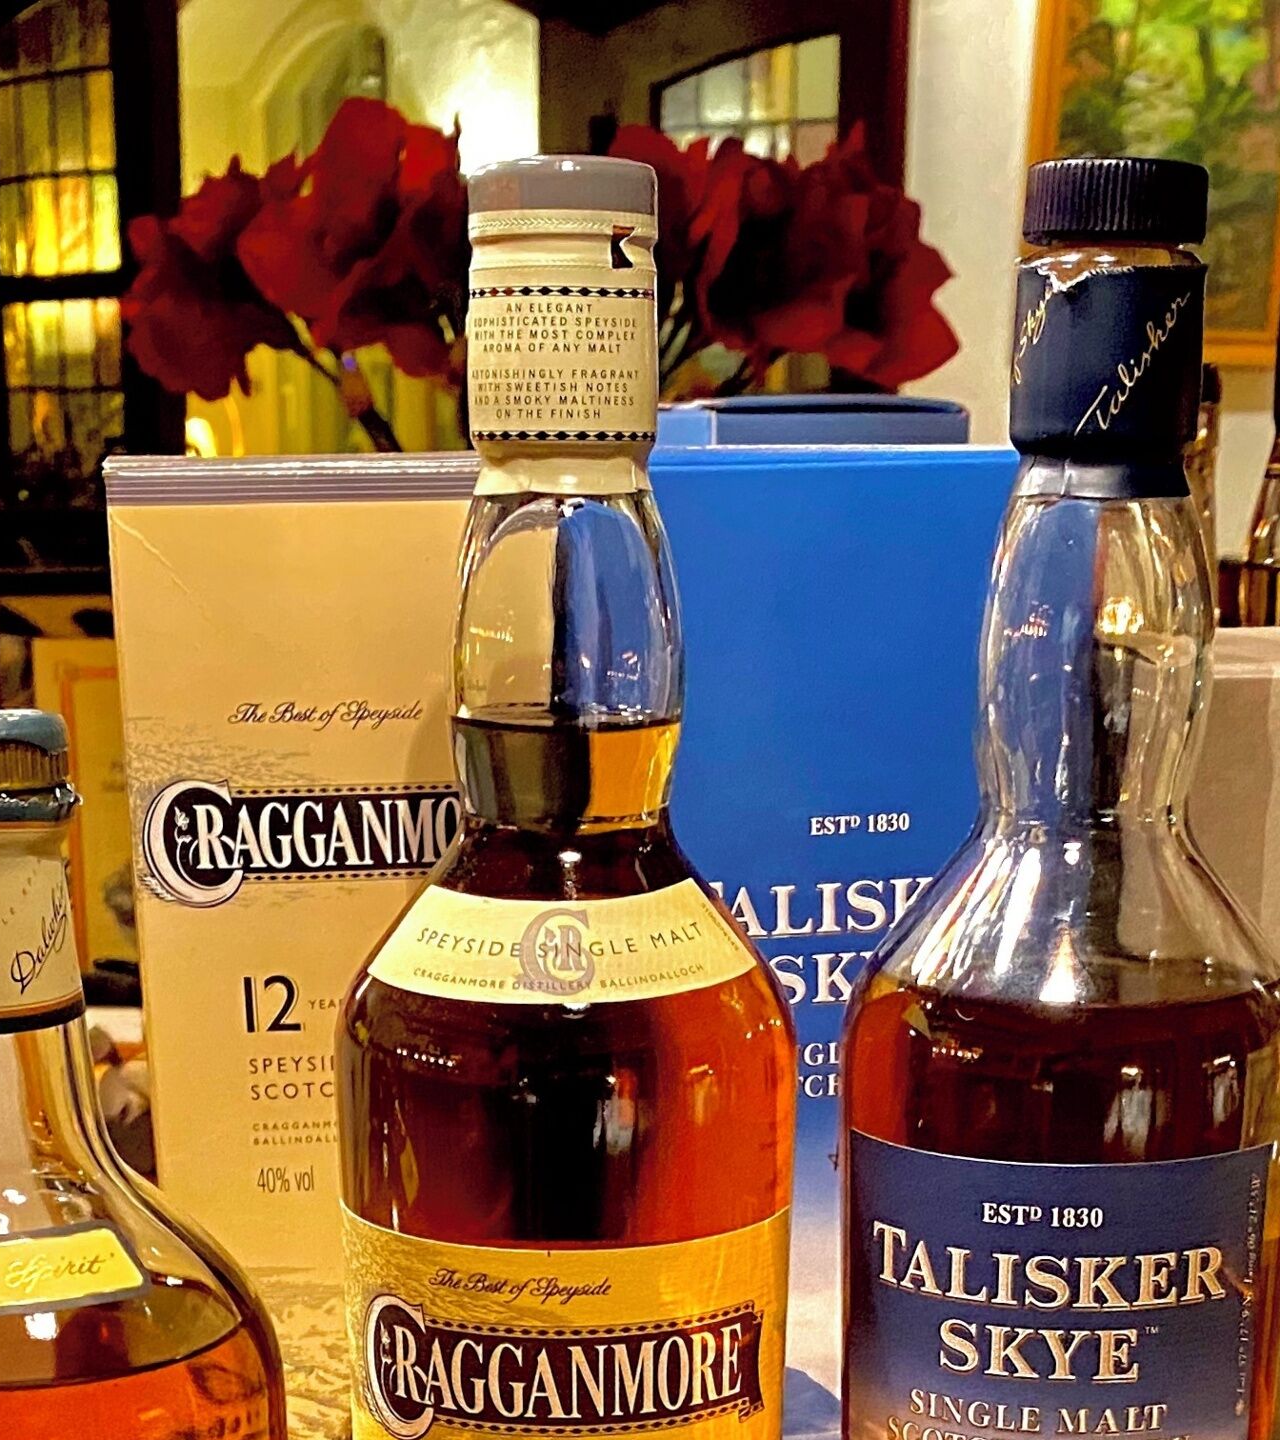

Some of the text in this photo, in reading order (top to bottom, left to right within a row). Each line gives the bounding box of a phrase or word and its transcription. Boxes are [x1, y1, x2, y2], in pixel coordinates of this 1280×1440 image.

[506, 303, 593, 313] AN ELEGANT
[473, 316, 637, 328] SOPHISTICATED SPEYSIDE
[500, 330, 636, 341] THE MOST COMPLEX
[483, 343, 621, 353] AROMA OF ANY MALT
[571, 368, 639, 380] FRAGRANT
[1074, 292, 1191, 437] Talisker
[505, 395, 634, 406] SMOKY MALTINESS
[506, 382, 628, 393] SWEETISH NOTES
[496, 408, 601, 419] ON THE FINISH
[228, 700, 423, 731] The Best of Speyside
[867, 813, 910, 832] 1830
[143, 779, 465, 908] CRAGGANMO
[718, 876, 934, 939] ALISK
[417, 927, 521, 957] SPEYSIDE
[537, 937, 635, 958] SINGLE
[650, 921, 704, 949] MALT
[412, 963, 704, 990] CRAGGANMORE BALLINDALLOCH
[243, 975, 304, 1033] 12
[257, 1165, 315, 1193] 40% vol
[1050, 1206, 1104, 1229] 1830
[873, 1220, 1226, 1309] TALISKER
[428, 1268, 614, 1306] The Best of Speyside
[939, 1319, 1140, 1383] SKYE
[910, 1389, 1168, 1437] SINGLE MALT
